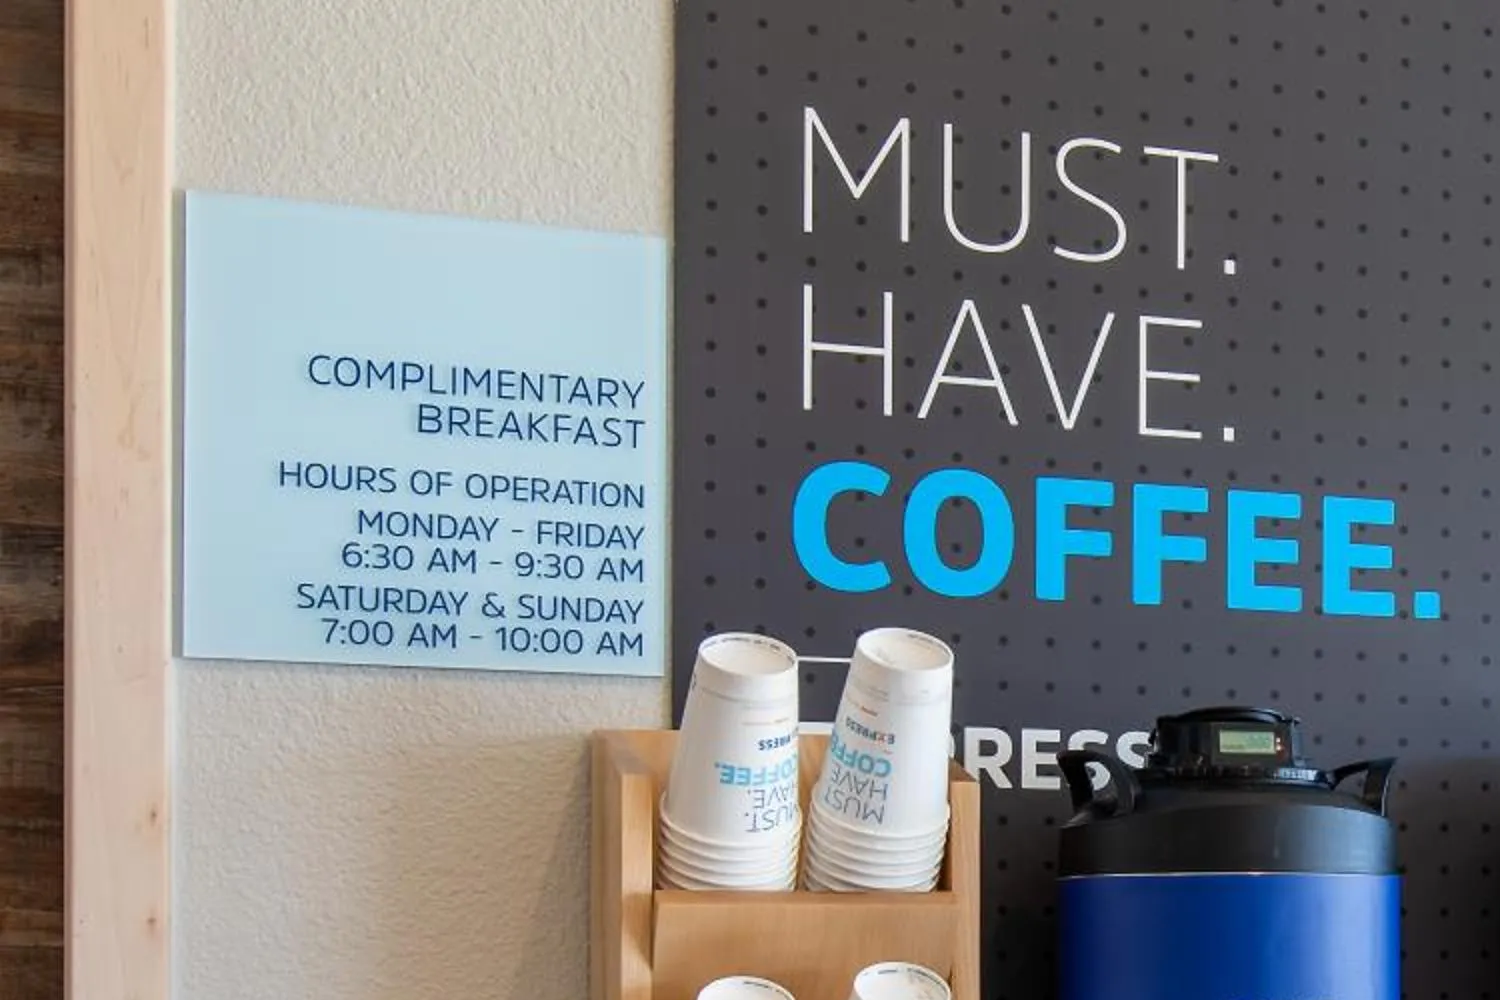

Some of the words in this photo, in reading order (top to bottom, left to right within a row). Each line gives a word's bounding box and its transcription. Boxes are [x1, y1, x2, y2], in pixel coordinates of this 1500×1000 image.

[803, 106, 1236, 275] MUST.
[307, 354, 646, 409] COMPLIMENTARY
[803, 283, 1236, 443] HAVE.
[416, 403, 646, 449] BREAKFAST
[278, 460, 397, 494] HOURS
[409, 469, 454, 496] OF
[464, 472, 645, 509] OPERATION
[357, 509, 499, 542] MONDAY
[536, 520, 645, 551] FRIDAY
[791, 460, 1442, 620] COFFEE.
[341, 542, 414, 572] 6:30
[426, 547, 478, 574] AM
[514, 551, 585, 580] 9:30
[595, 557, 644, 583] AM
[296, 582, 469, 617] SATURDAY
[481, 592, 506, 619] &
[516, 593, 645, 625] SUNDAY
[320, 617, 395, 647] 7:00
[406, 623, 457, 649] AM
[496, 626, 584, 655] 10:00
[595, 631, 644, 657] AM
